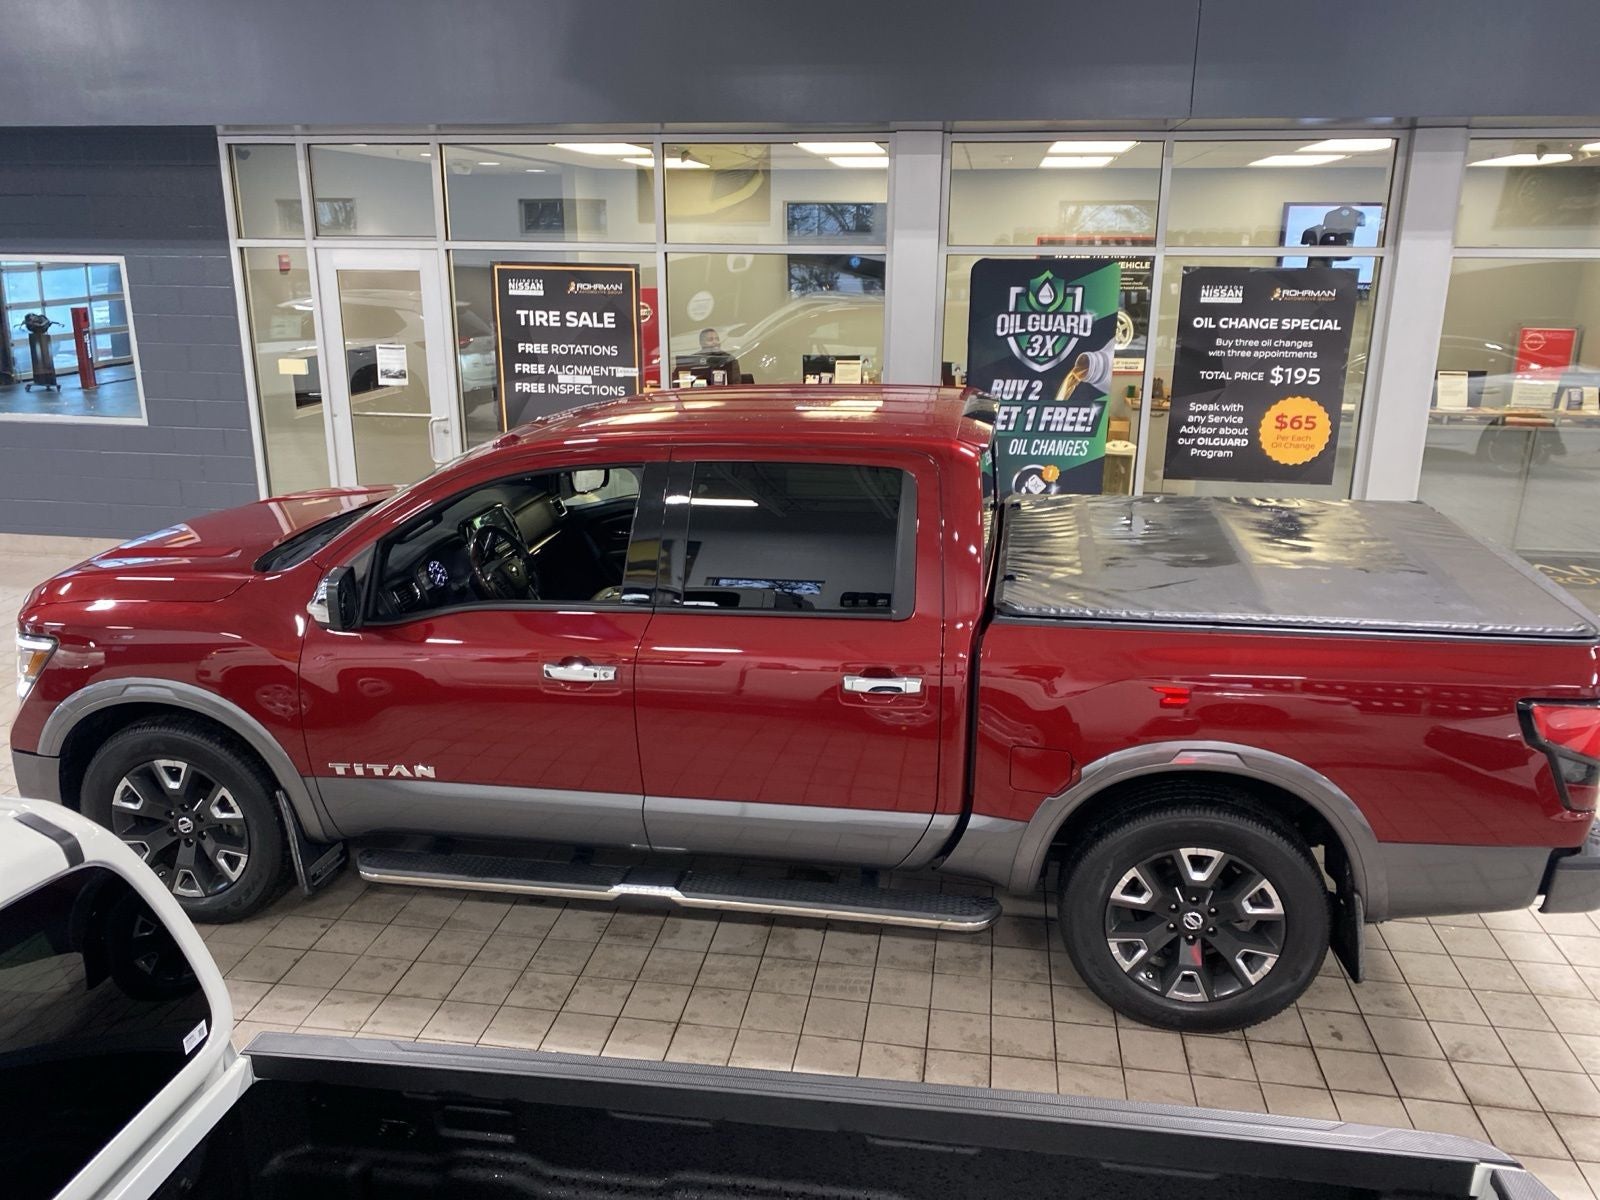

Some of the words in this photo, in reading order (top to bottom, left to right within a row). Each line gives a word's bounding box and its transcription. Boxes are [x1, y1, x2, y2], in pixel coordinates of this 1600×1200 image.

[576, 283, 622, 291] ROHRMAN
[1281, 288, 1337, 297] ROHRMAN
[1201, 289, 1243, 297] NISSAN
[516, 309, 561, 326] TIRE
[565, 311, 616, 328] SALE
[1193, 317, 1216, 328] OIL
[1219, 318, 1278, 329] CHANGE
[1281, 319, 1342, 330] SPECIAL
[1026, 334, 1059, 356] 3X
[1215, 338, 1233, 348] Buy
[1235, 338, 1259, 347] three
[1261, 339, 1272, 347] oil
[1273, 339, 1313, 349] changes
[518, 343, 548, 354] FREE
[551, 344, 618, 356] ROTATIONS
[1227, 349, 1251, 357] three
[1253, 350, 1318, 359] appointments
[515, 363, 545, 374] FREE
[1200, 371, 1232, 380] TOTAL
[1234, 372, 1264, 381] PRICE
[1270, 365, 1320, 386] $195
[515, 383, 545, 393] FREE
[548, 384, 625, 396] INSPECTIONS
[990, 379, 1029, 400] BUY
[1028, 380, 1043, 401] 2
[1189, 402, 1219, 412] Speak
[1221, 403, 1244, 412] with
[996, 406, 1021, 431] ET
[1025, 407, 1037, 431] 1
[1038, 405, 1096, 432] FREE!
[1188, 415, 1206, 424] any
[1207, 414, 1244, 424] Service
[1275, 413, 1317, 431] $65
[1180, 425, 1217, 434] Advisor
[1219, 426, 1248, 436] about
[1197, 437, 1249, 446] OILGUARD
[1284, 442, 1315, 450] Change
[1009, 439, 1027, 455] OIL
[1030, 439, 1089, 457] CHANGES
[1191, 448, 1233, 459] Program
[328, 763, 436, 778] TITAN
